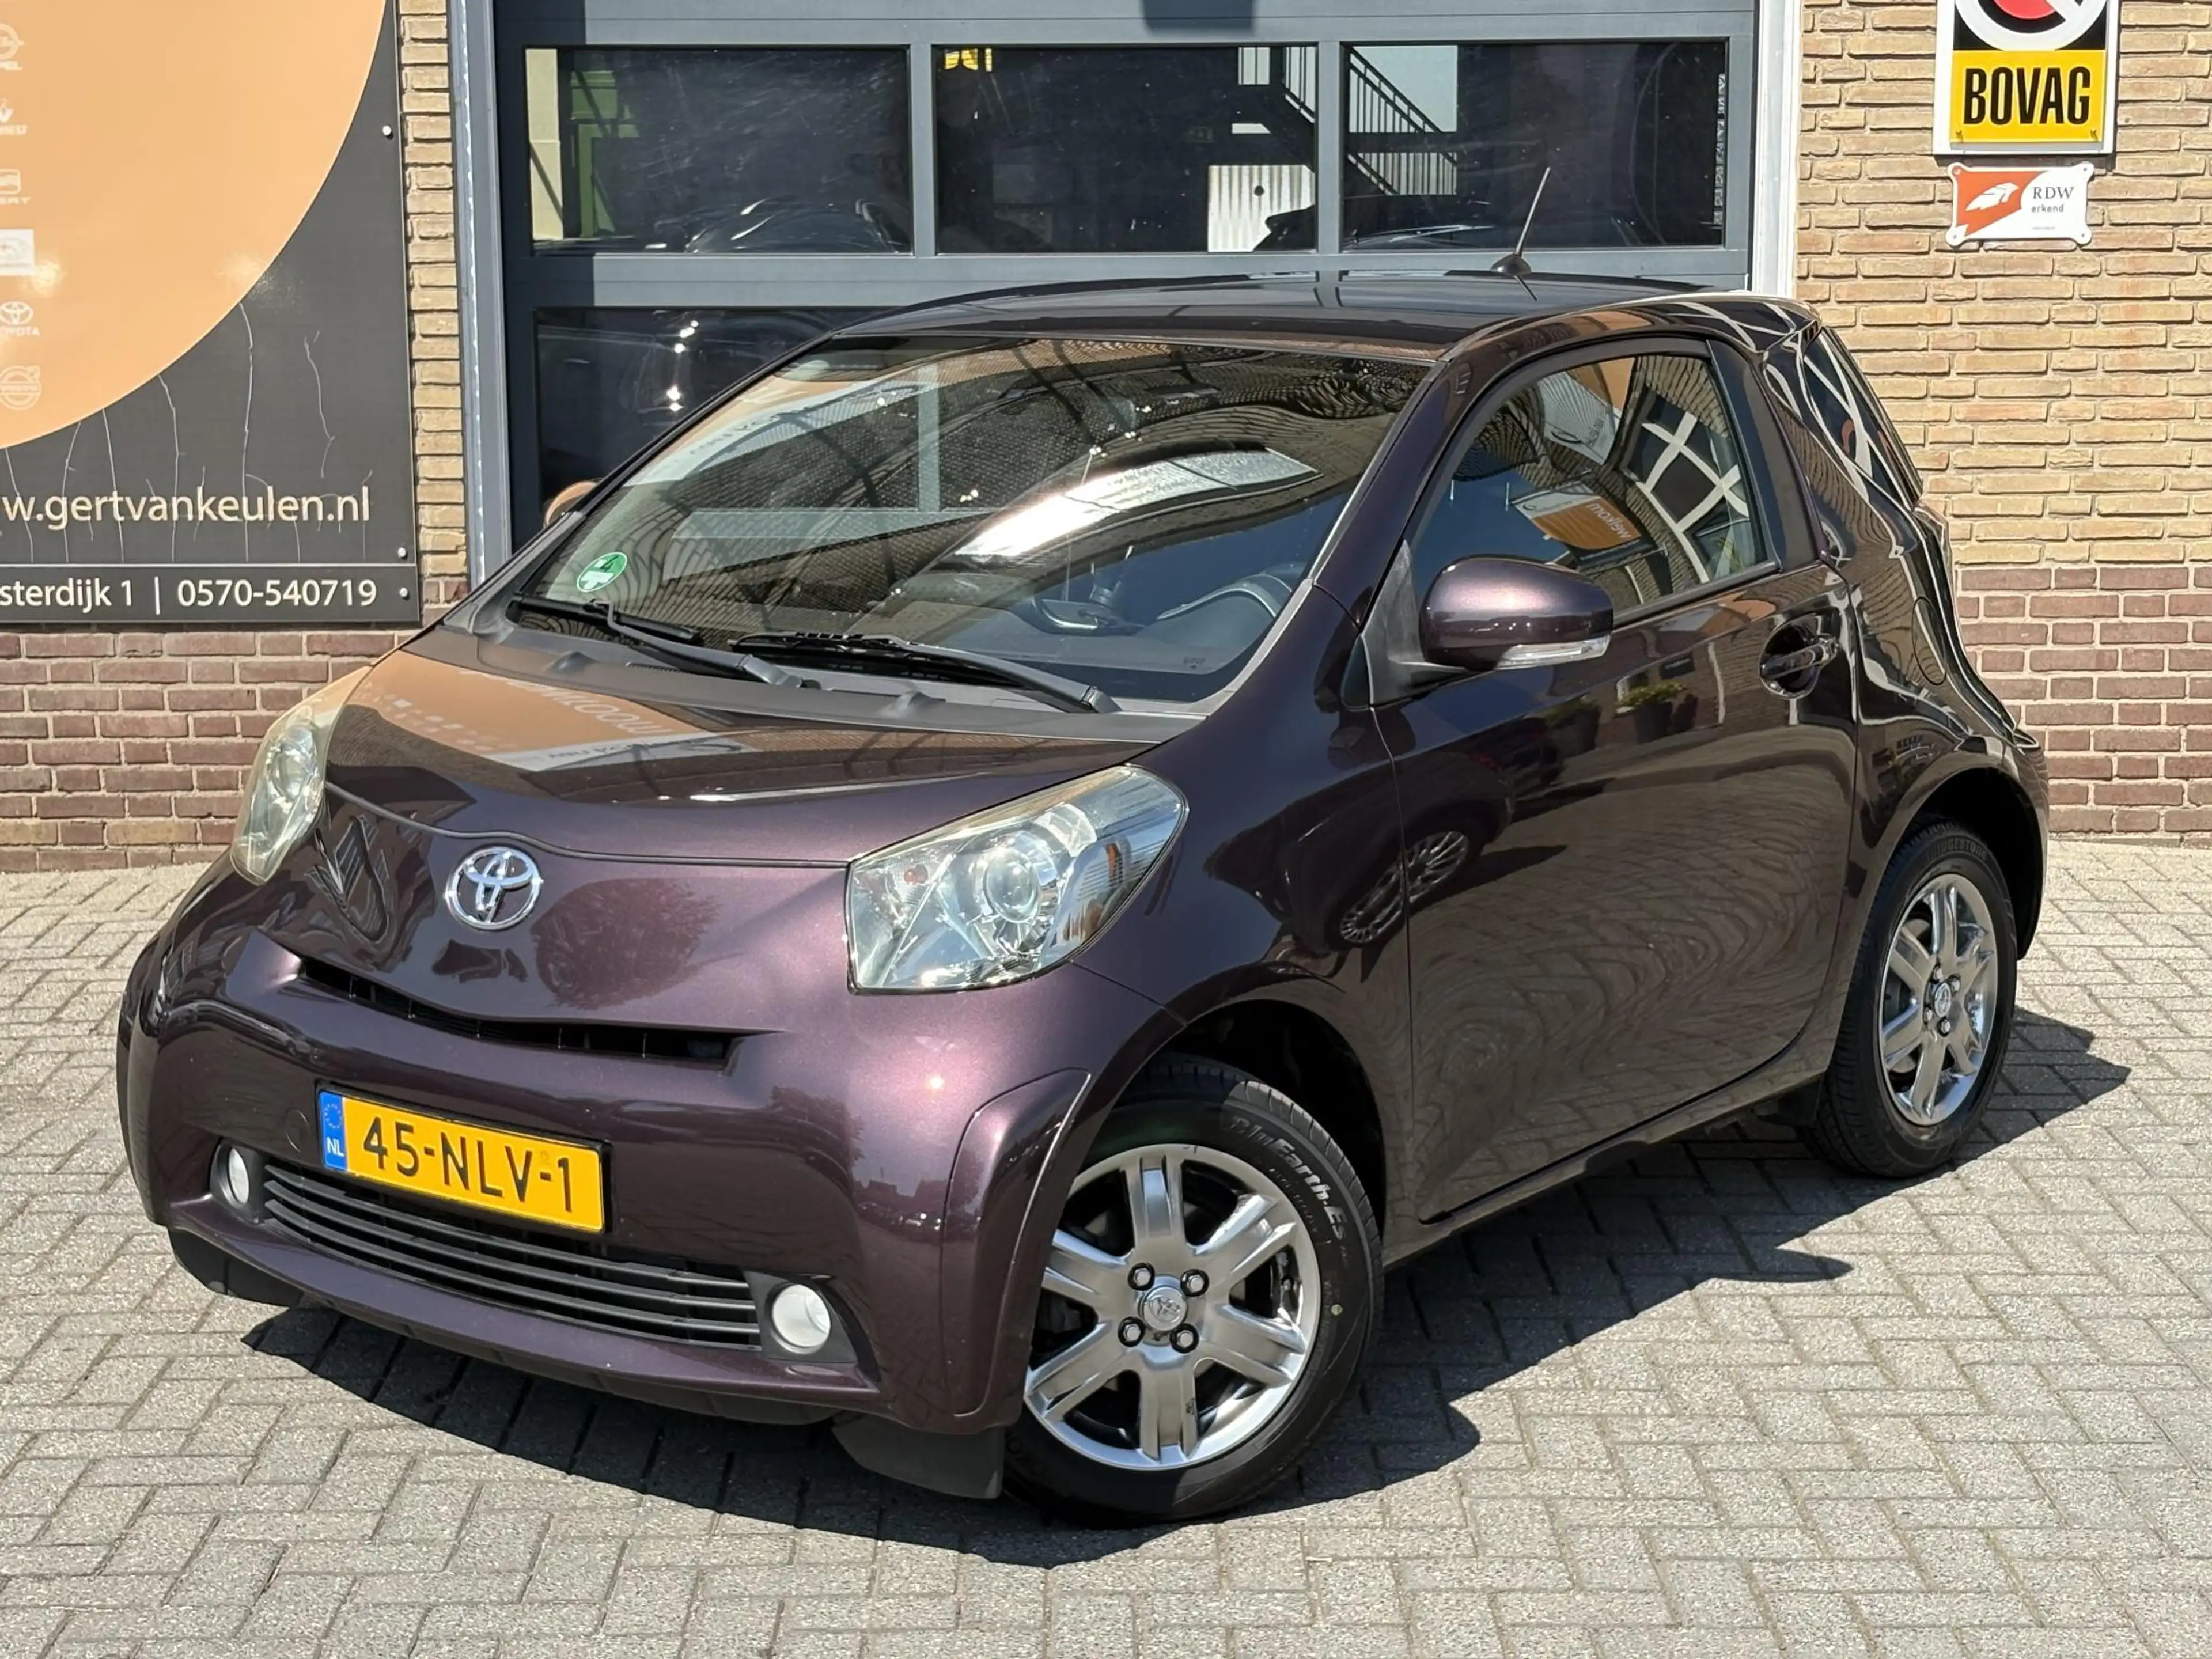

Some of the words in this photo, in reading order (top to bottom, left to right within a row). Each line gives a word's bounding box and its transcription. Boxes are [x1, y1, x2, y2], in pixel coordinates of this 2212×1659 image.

[1963, 66, 2091, 125] BOVAG
[2032, 186, 2074, 200] RDW
[2031, 204, 2064, 213] erkend
[121, 579, 132, 606] 1
[177, 579, 377, 607] 0570-540719
[327, 1135, 346, 1157] NL
[363, 1116, 573, 1213] 45-NLV-1
